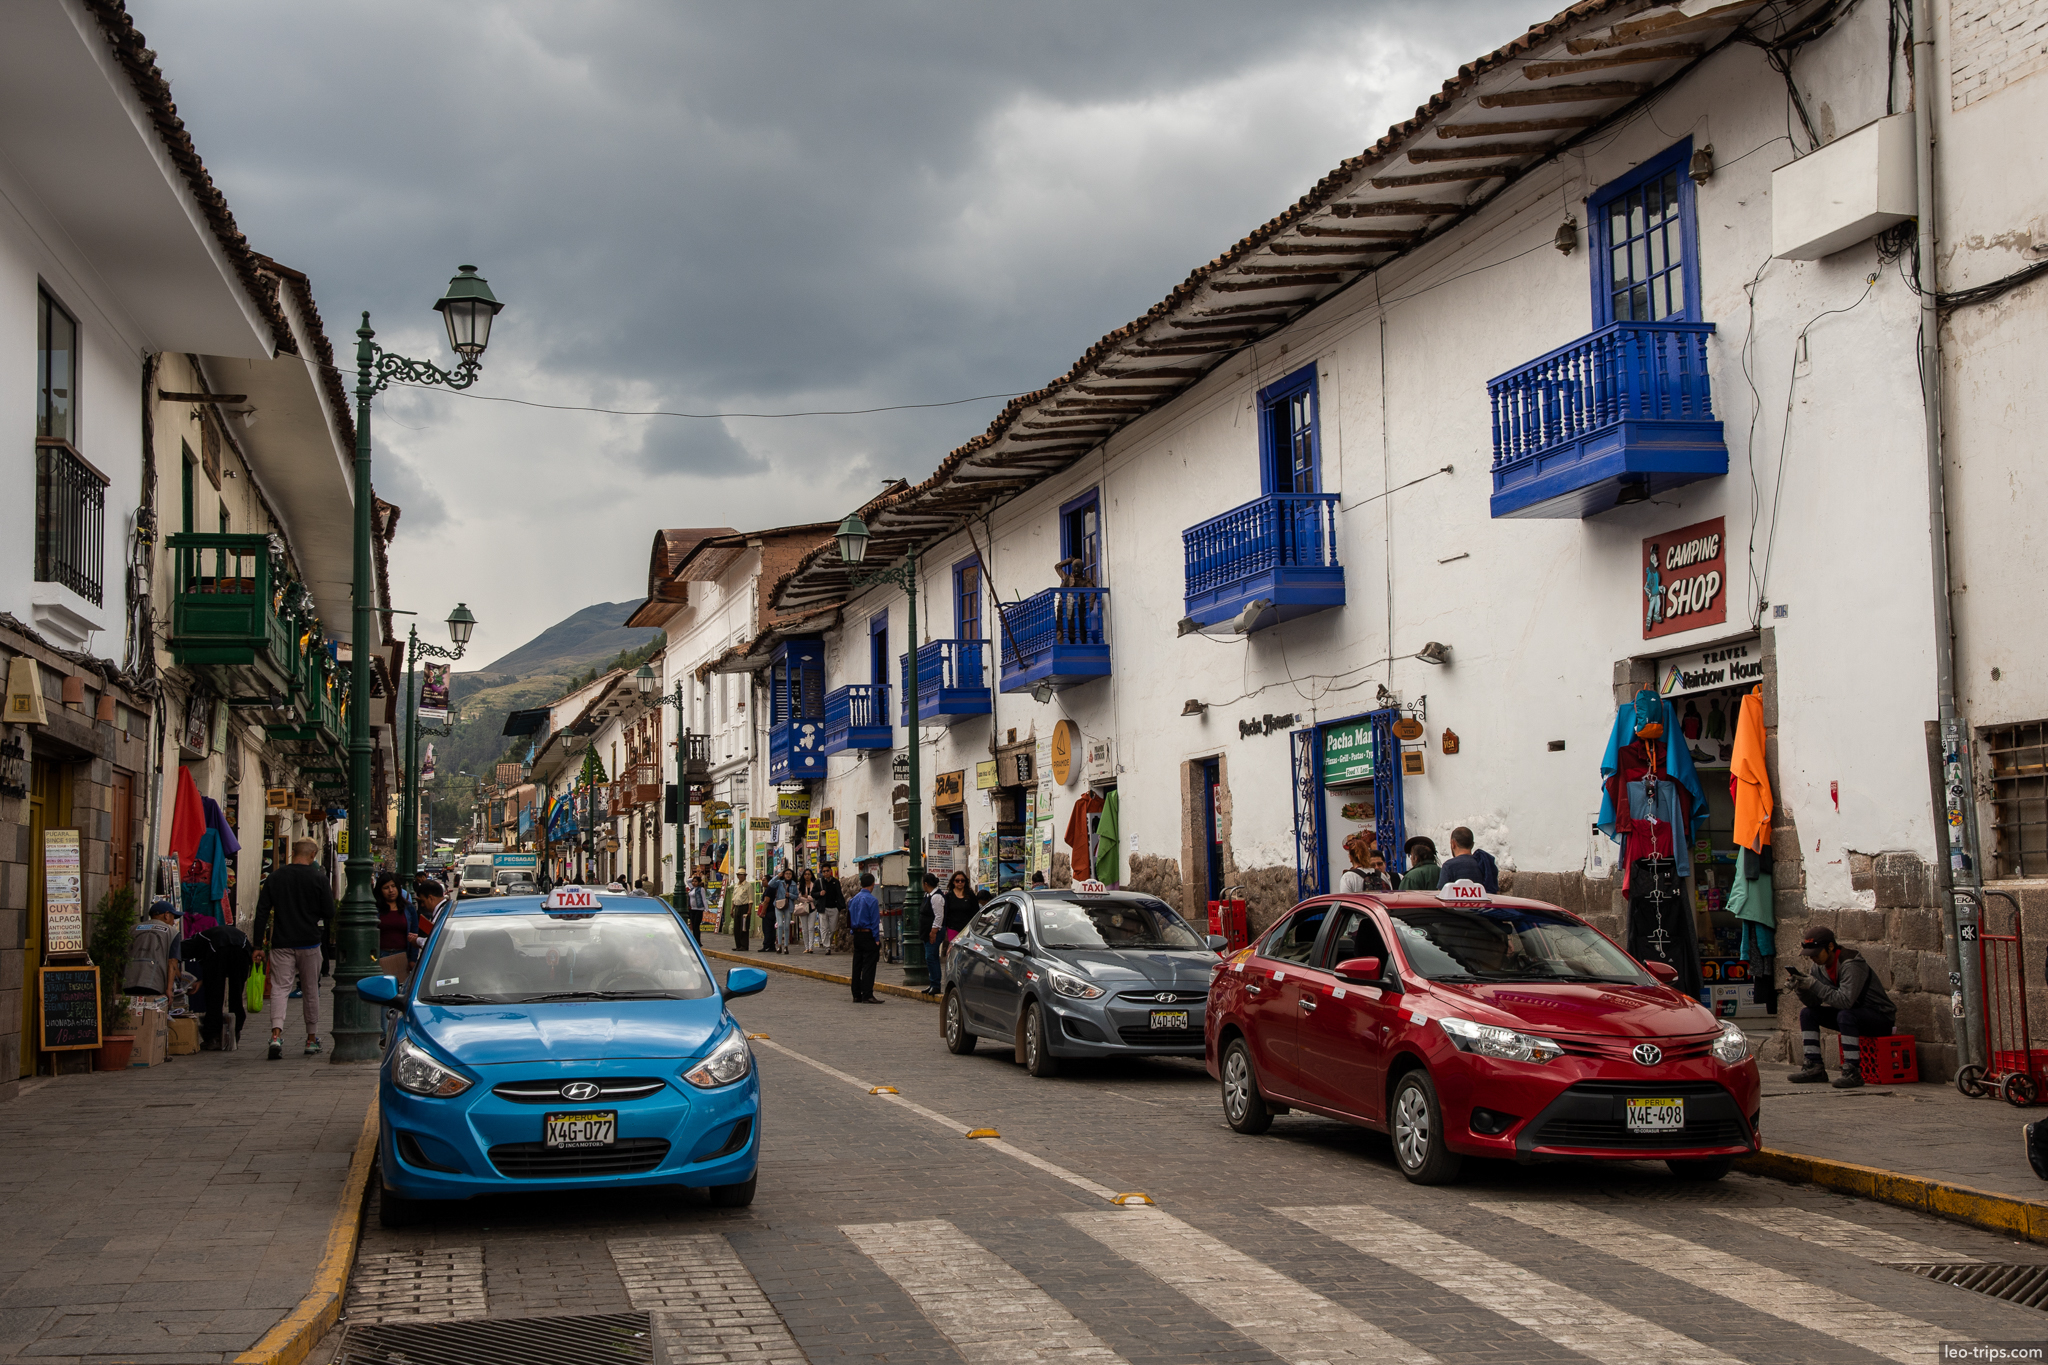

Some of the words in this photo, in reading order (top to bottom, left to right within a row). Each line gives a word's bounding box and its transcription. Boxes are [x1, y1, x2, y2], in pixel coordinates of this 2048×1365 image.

[1666, 533, 1720, 571] CAMPING
[1666, 570, 1721, 619] SHOP
[1774, 605, 1787, 618] 306
[1702, 646, 1748, 664] TRAVEL
[1683, 668, 1724, 690] Rainbow
[1326, 732, 1353, 752] Pacha
[1444, 740, 1454, 749] VISA
[1340, 754, 1349, 763] Grill
[780, 800, 809, 810] MASSAGE
[1082, 884, 1103, 892] TAXI
[1453, 887, 1482, 898] TAXI
[557, 894, 590, 906] TAXI
[51, 940, 82, 950] UDON
[45, 973, 64, 981] MENU
[75, 972, 89, 982] HOY
[76, 1010, 95, 1018] POLLO
[1152, 1016, 1186, 1027] X4D-054
[1629, 1106, 1681, 1124] X4E-498
[549, 1121, 612, 1142] X4G-077
